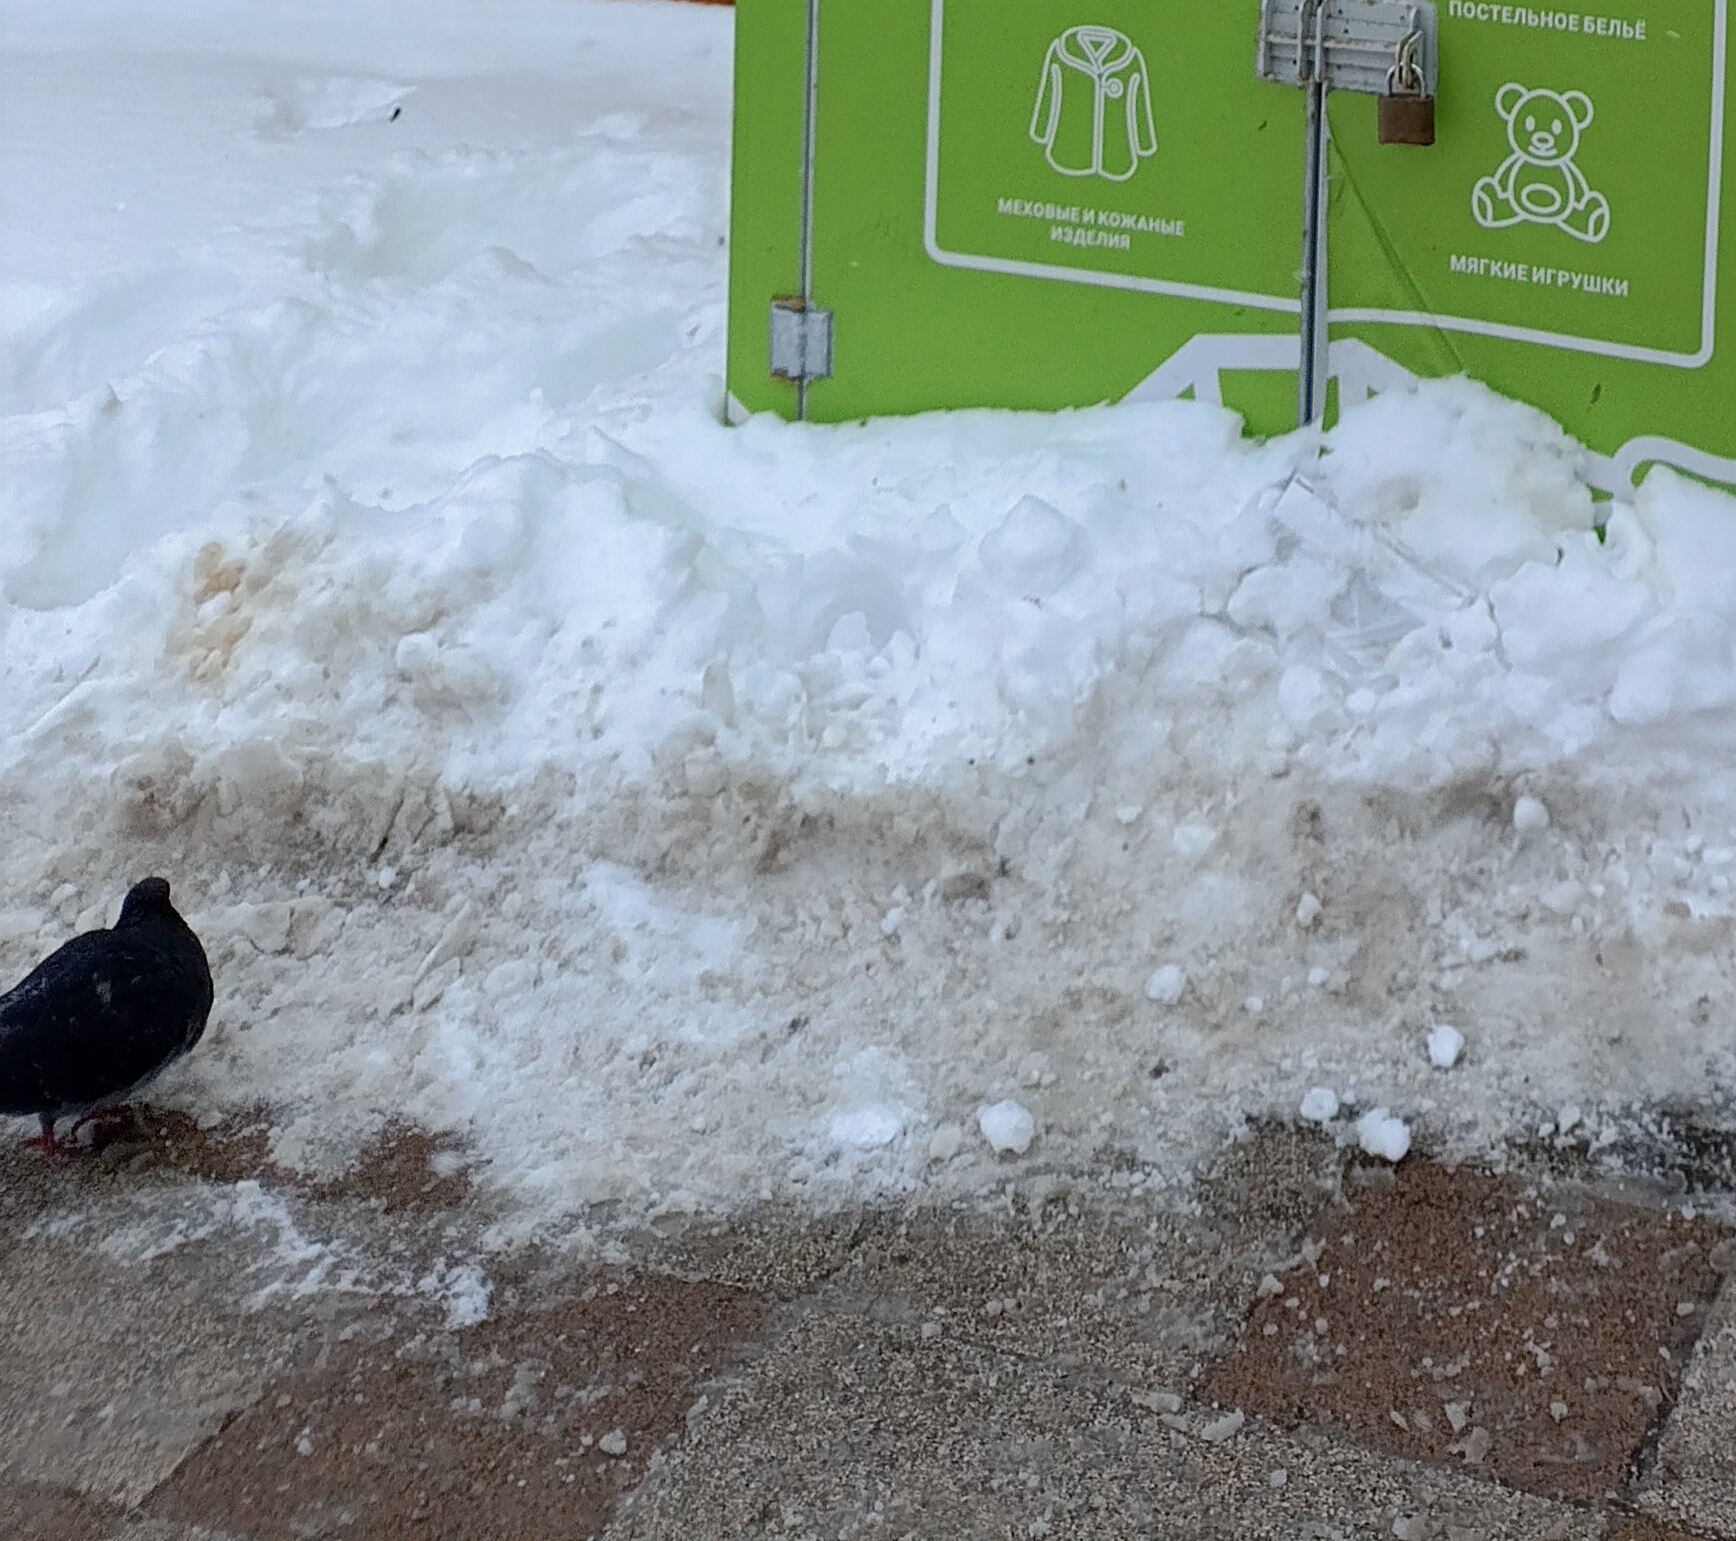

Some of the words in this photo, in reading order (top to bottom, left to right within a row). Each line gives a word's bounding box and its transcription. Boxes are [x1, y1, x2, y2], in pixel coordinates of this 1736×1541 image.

[1583, 17, 1647, 41] БЕЛЬЁ
[997, 197, 1080, 223] МЕХОВЫЕ
[1082, 207, 1096, 225] И
[1098, 207, 1185, 237] КОЖАНЫЕ
[1049, 226, 1131, 251] ИЗДЕЛИЯ
[1449, 254, 1529, 283] МЯГКИЕ
[1531, 265, 1630, 299] ИГРУШКИ
